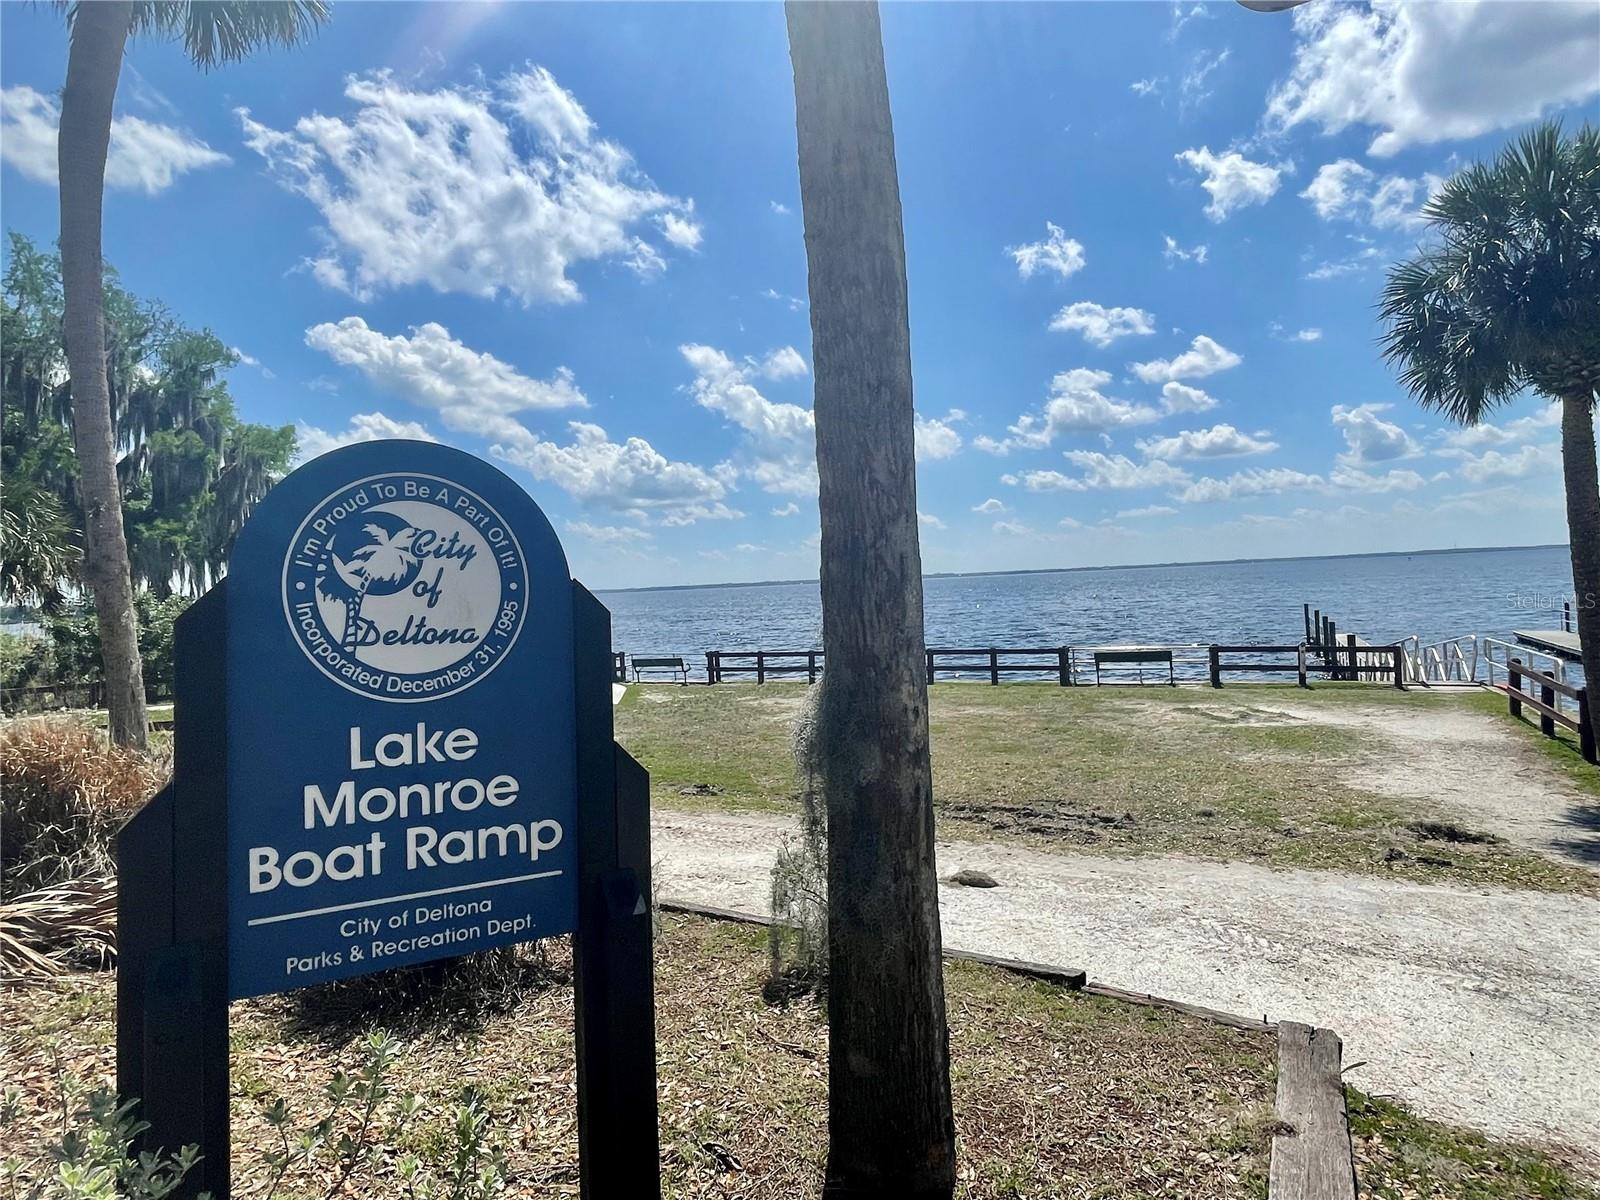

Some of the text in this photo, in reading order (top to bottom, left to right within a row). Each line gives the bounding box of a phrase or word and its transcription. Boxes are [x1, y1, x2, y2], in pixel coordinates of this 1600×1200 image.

[295, 481, 517, 569] I'm Proud To Be A Part Of It!
[410, 531, 477, 571] City
[413, 567, 444, 608] of
[295, 601, 518, 693] Incorporated December 31, 1995
[350, 614, 480, 647] Deltona
[350, 722, 479, 770] Lake
[304, 774, 520, 829] Monroe
[249, 819, 563, 893] Boat Ramp
[286, 914, 537, 974] Parks & Recreation Dept.
[340, 899, 492, 938] City of Deltona
